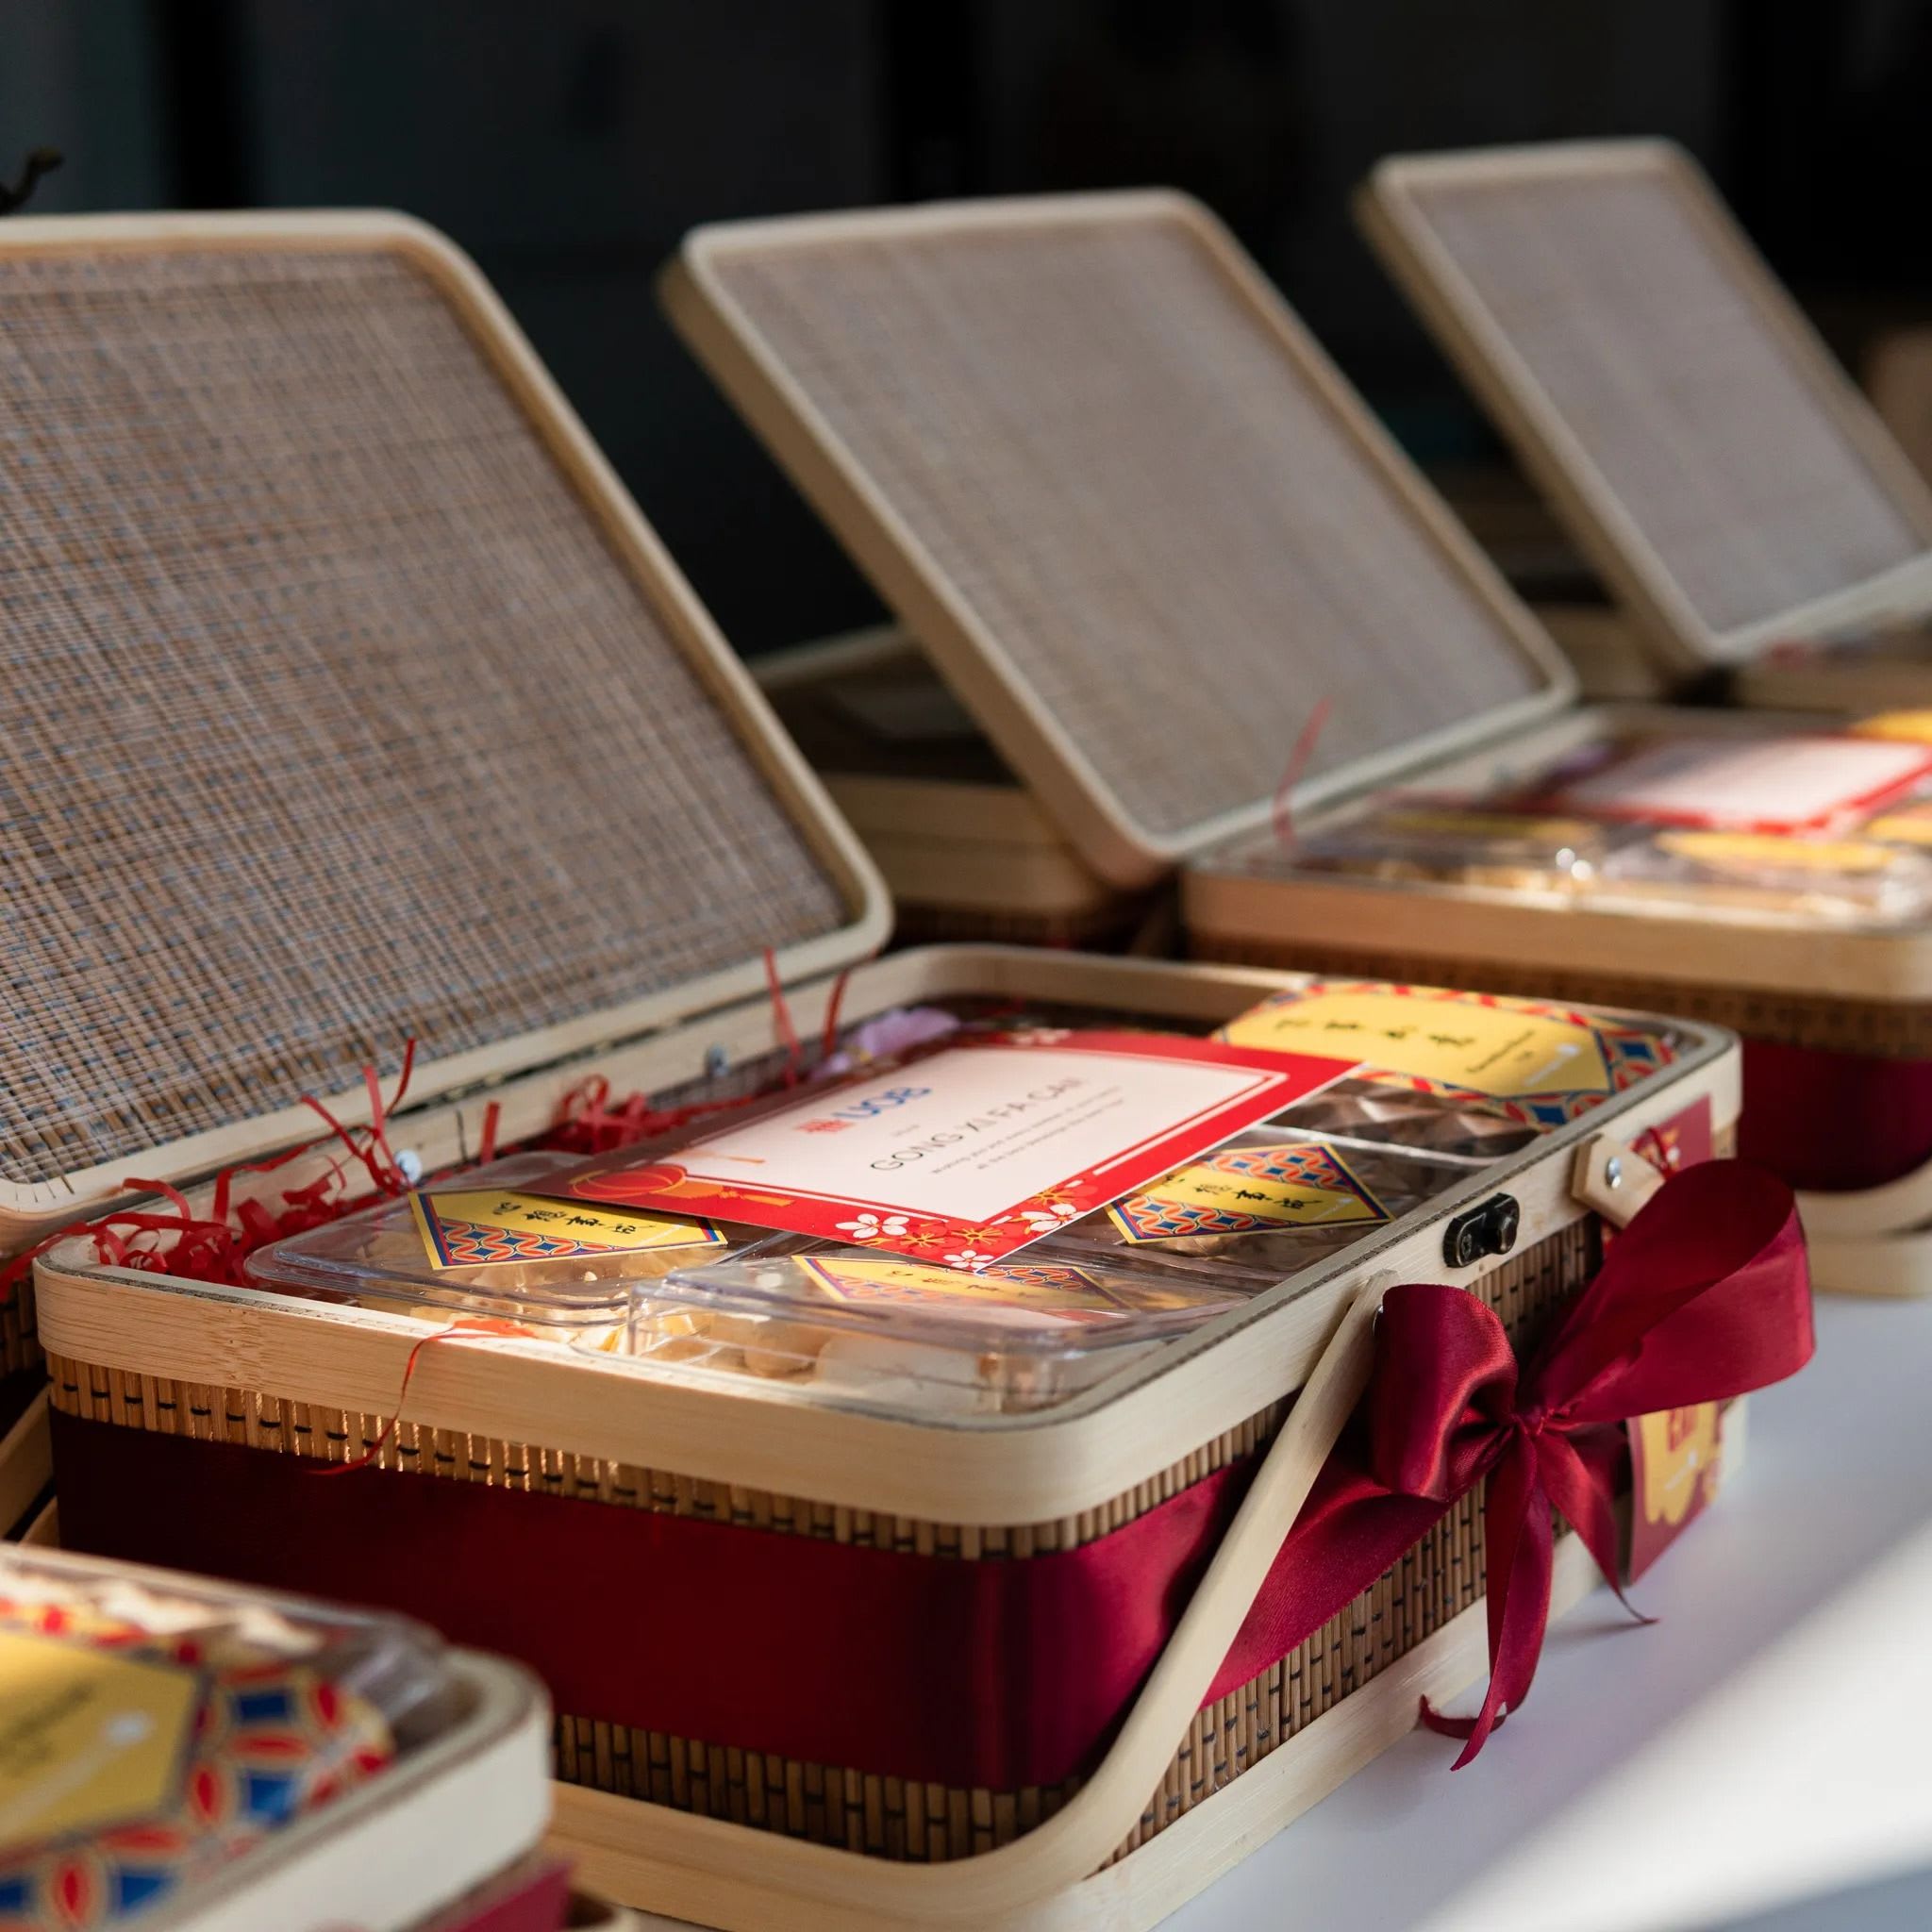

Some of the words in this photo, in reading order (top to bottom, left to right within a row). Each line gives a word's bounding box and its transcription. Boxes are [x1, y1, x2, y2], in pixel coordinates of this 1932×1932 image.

[832, 1088, 932, 1119] UOB
[870, 1131, 964, 1171] GONG
[952, 1116, 998, 1132] XI
[986, 1102, 1038, 1119] FA
